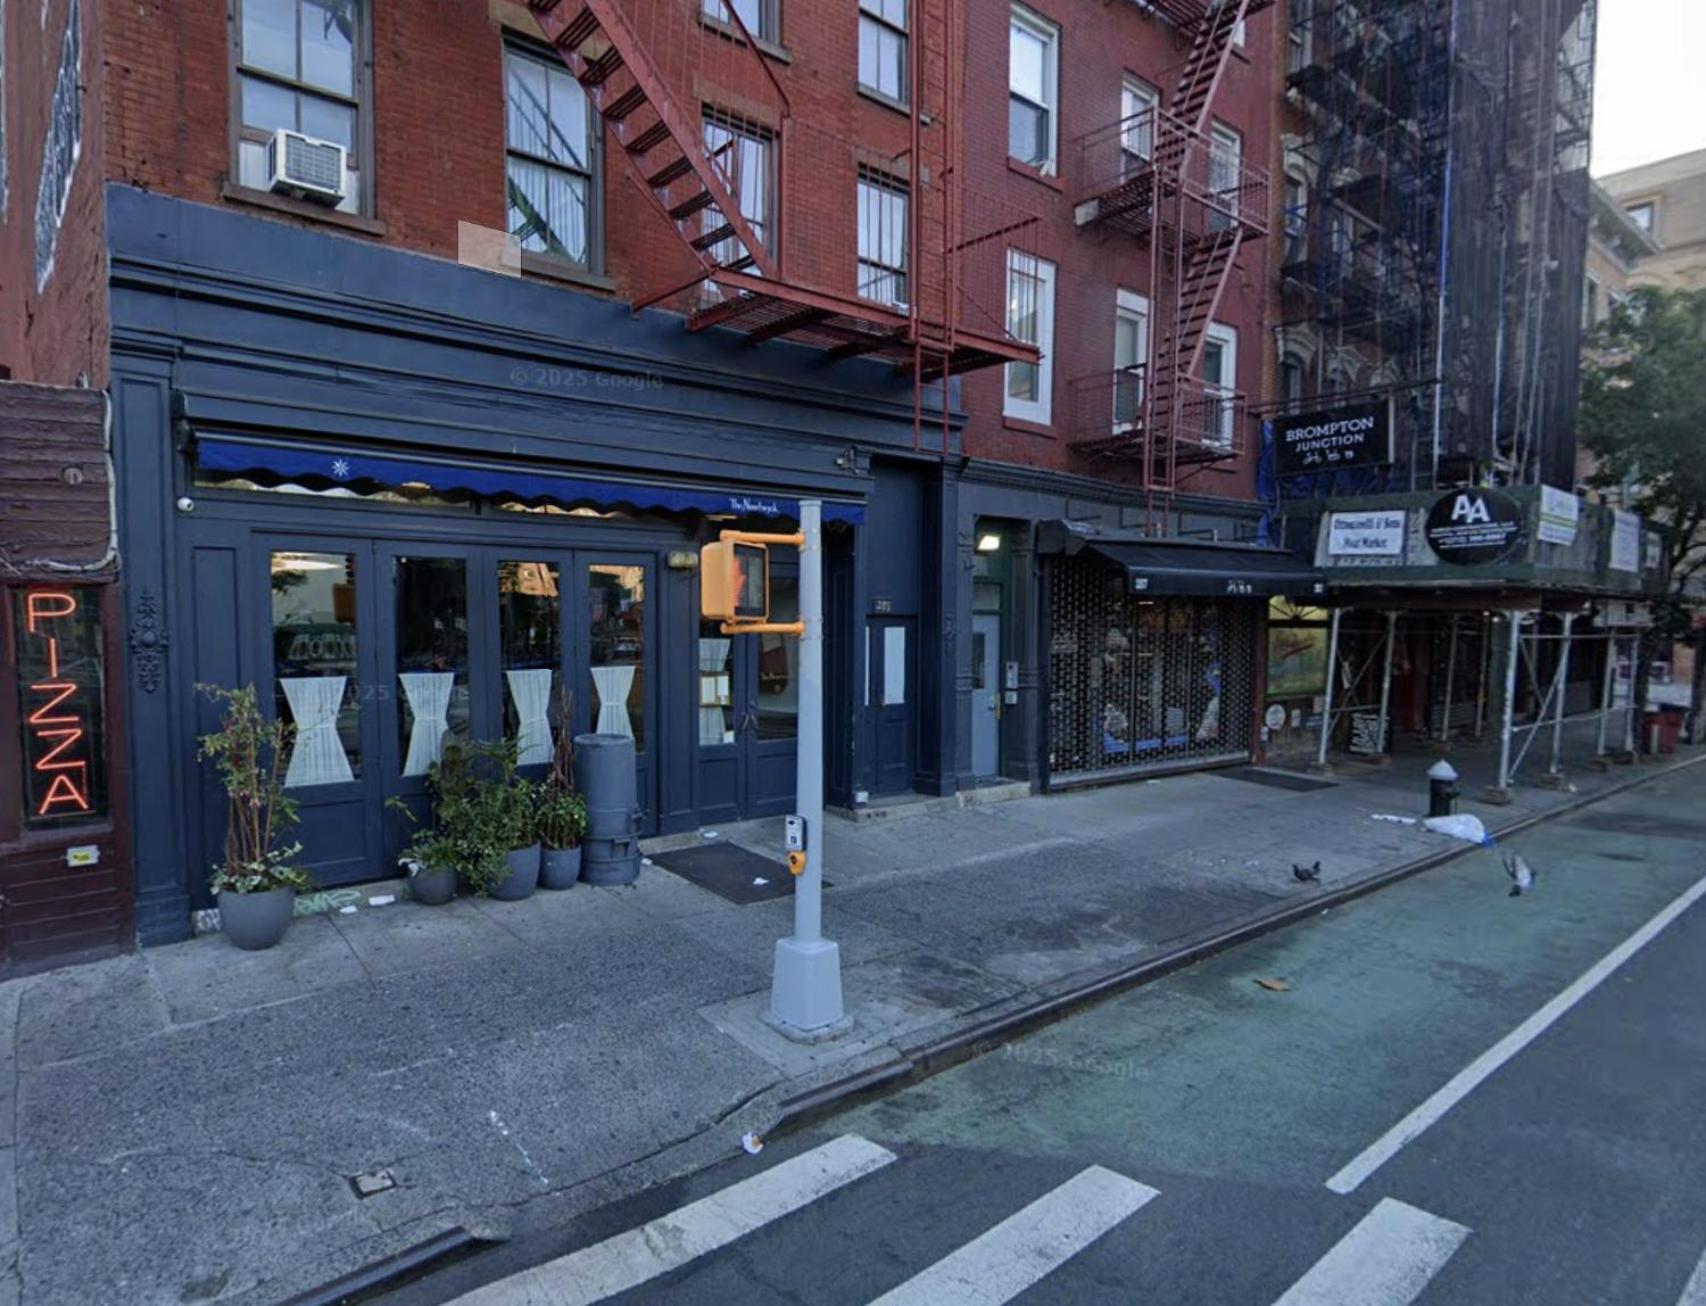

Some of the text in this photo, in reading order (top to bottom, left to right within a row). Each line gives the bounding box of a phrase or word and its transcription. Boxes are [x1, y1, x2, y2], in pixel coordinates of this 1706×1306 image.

[1285, 416, 1374, 442] BROMPTON
[1295, 433, 1364, 452] JUNCTION
[1451, 494, 1491, 523] AA
[28, 593, 88, 816] PIZZA
